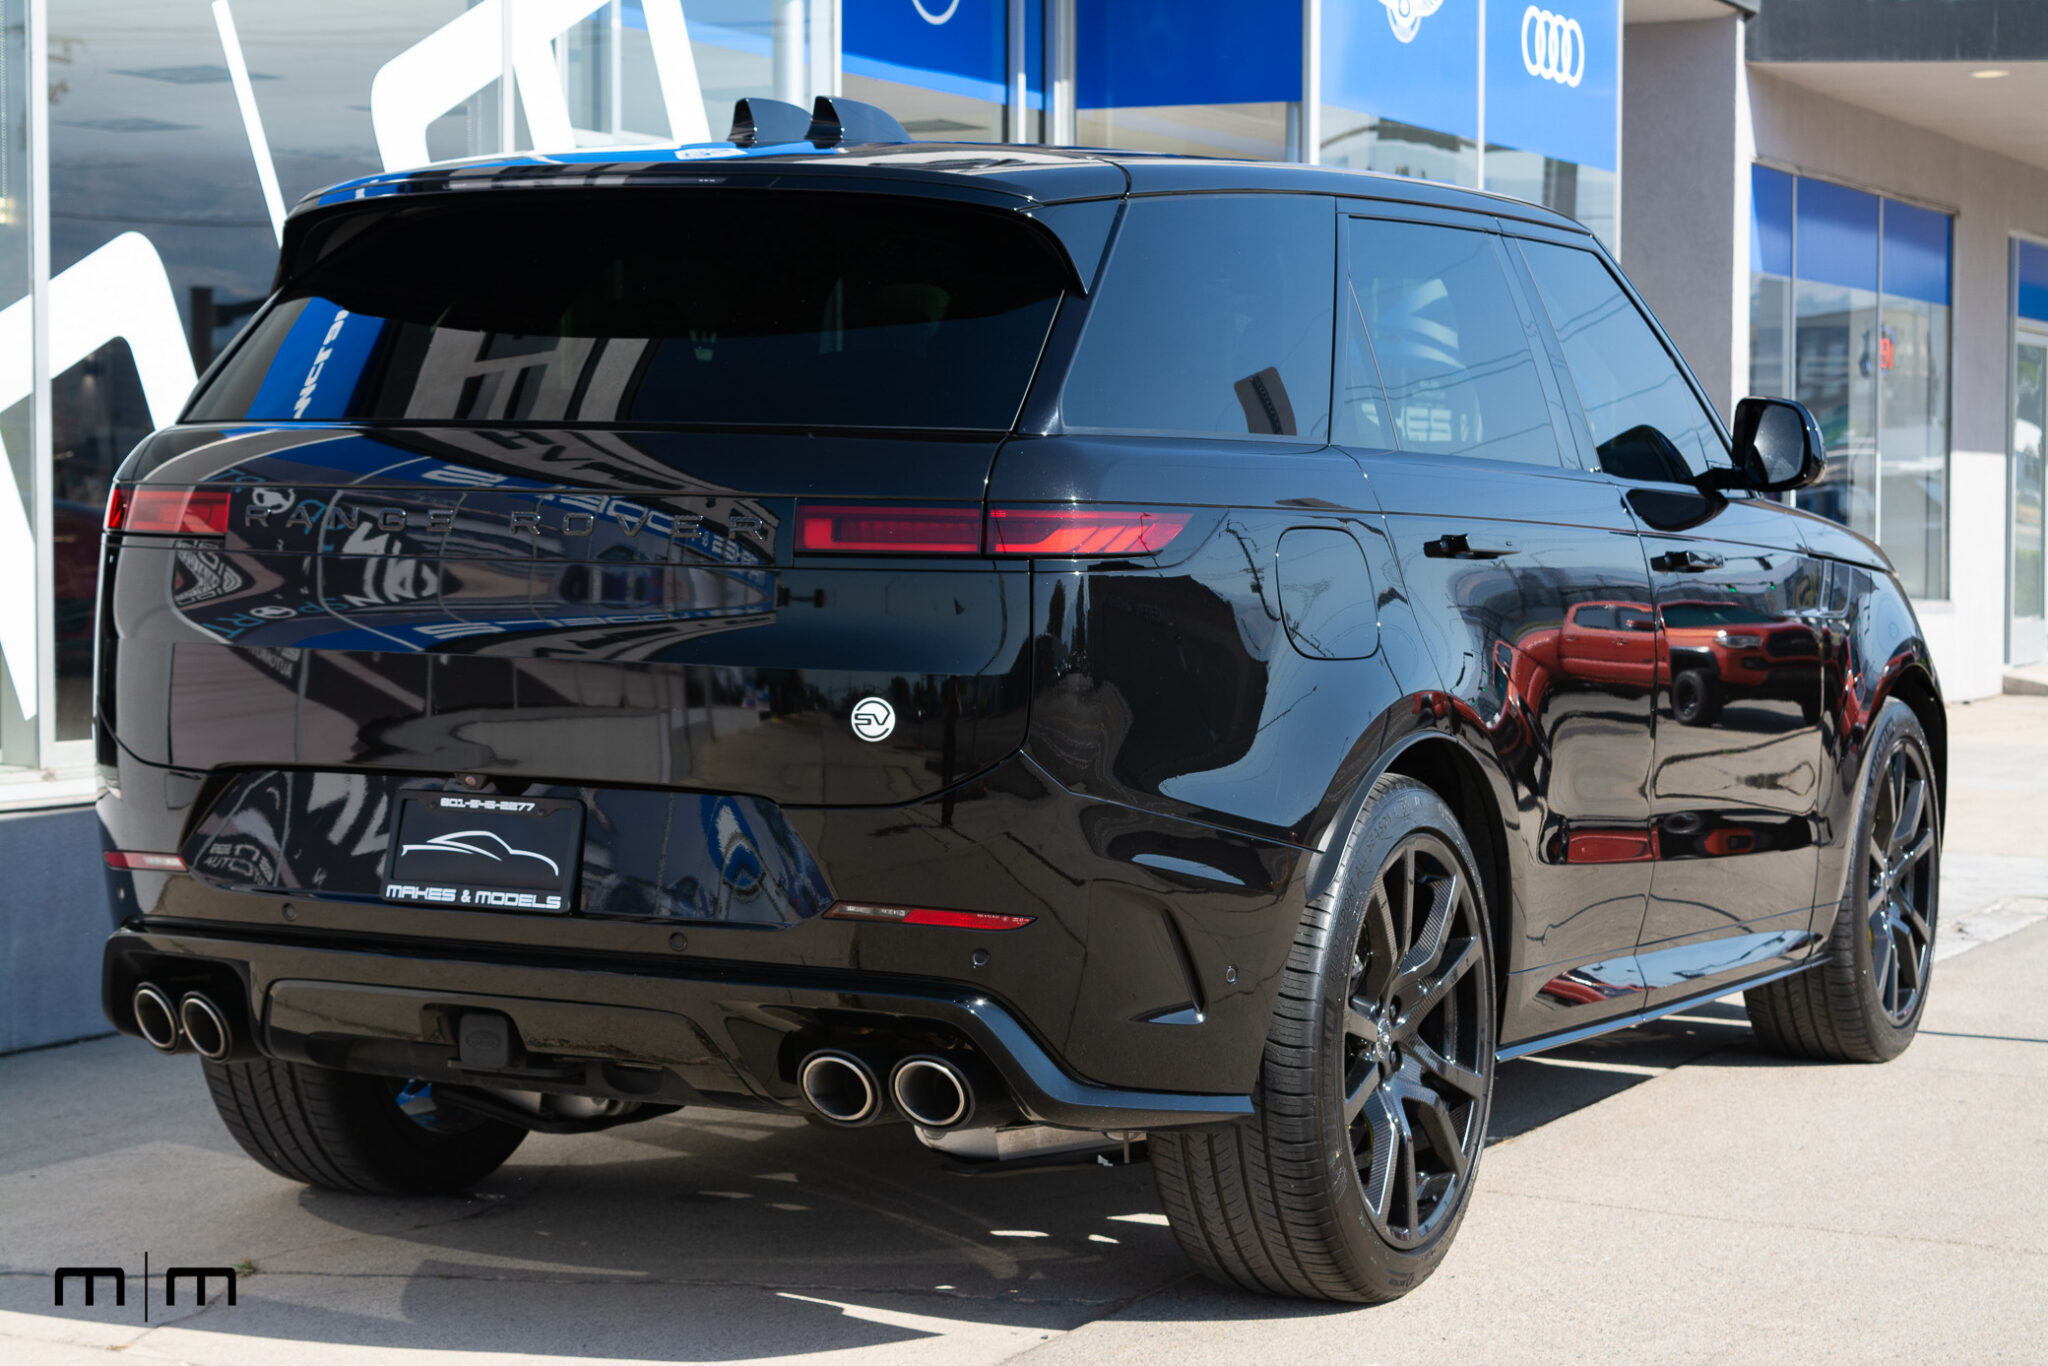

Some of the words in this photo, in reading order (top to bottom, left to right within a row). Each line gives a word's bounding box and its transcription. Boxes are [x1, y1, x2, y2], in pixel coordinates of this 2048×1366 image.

[245, 504, 454, 532] RANGE
[510, 510, 768, 541] ROVER
[385, 884, 457, 902] MAKES
[461, 889, 472, 904] &
[475, 890, 562, 910] MODELS
